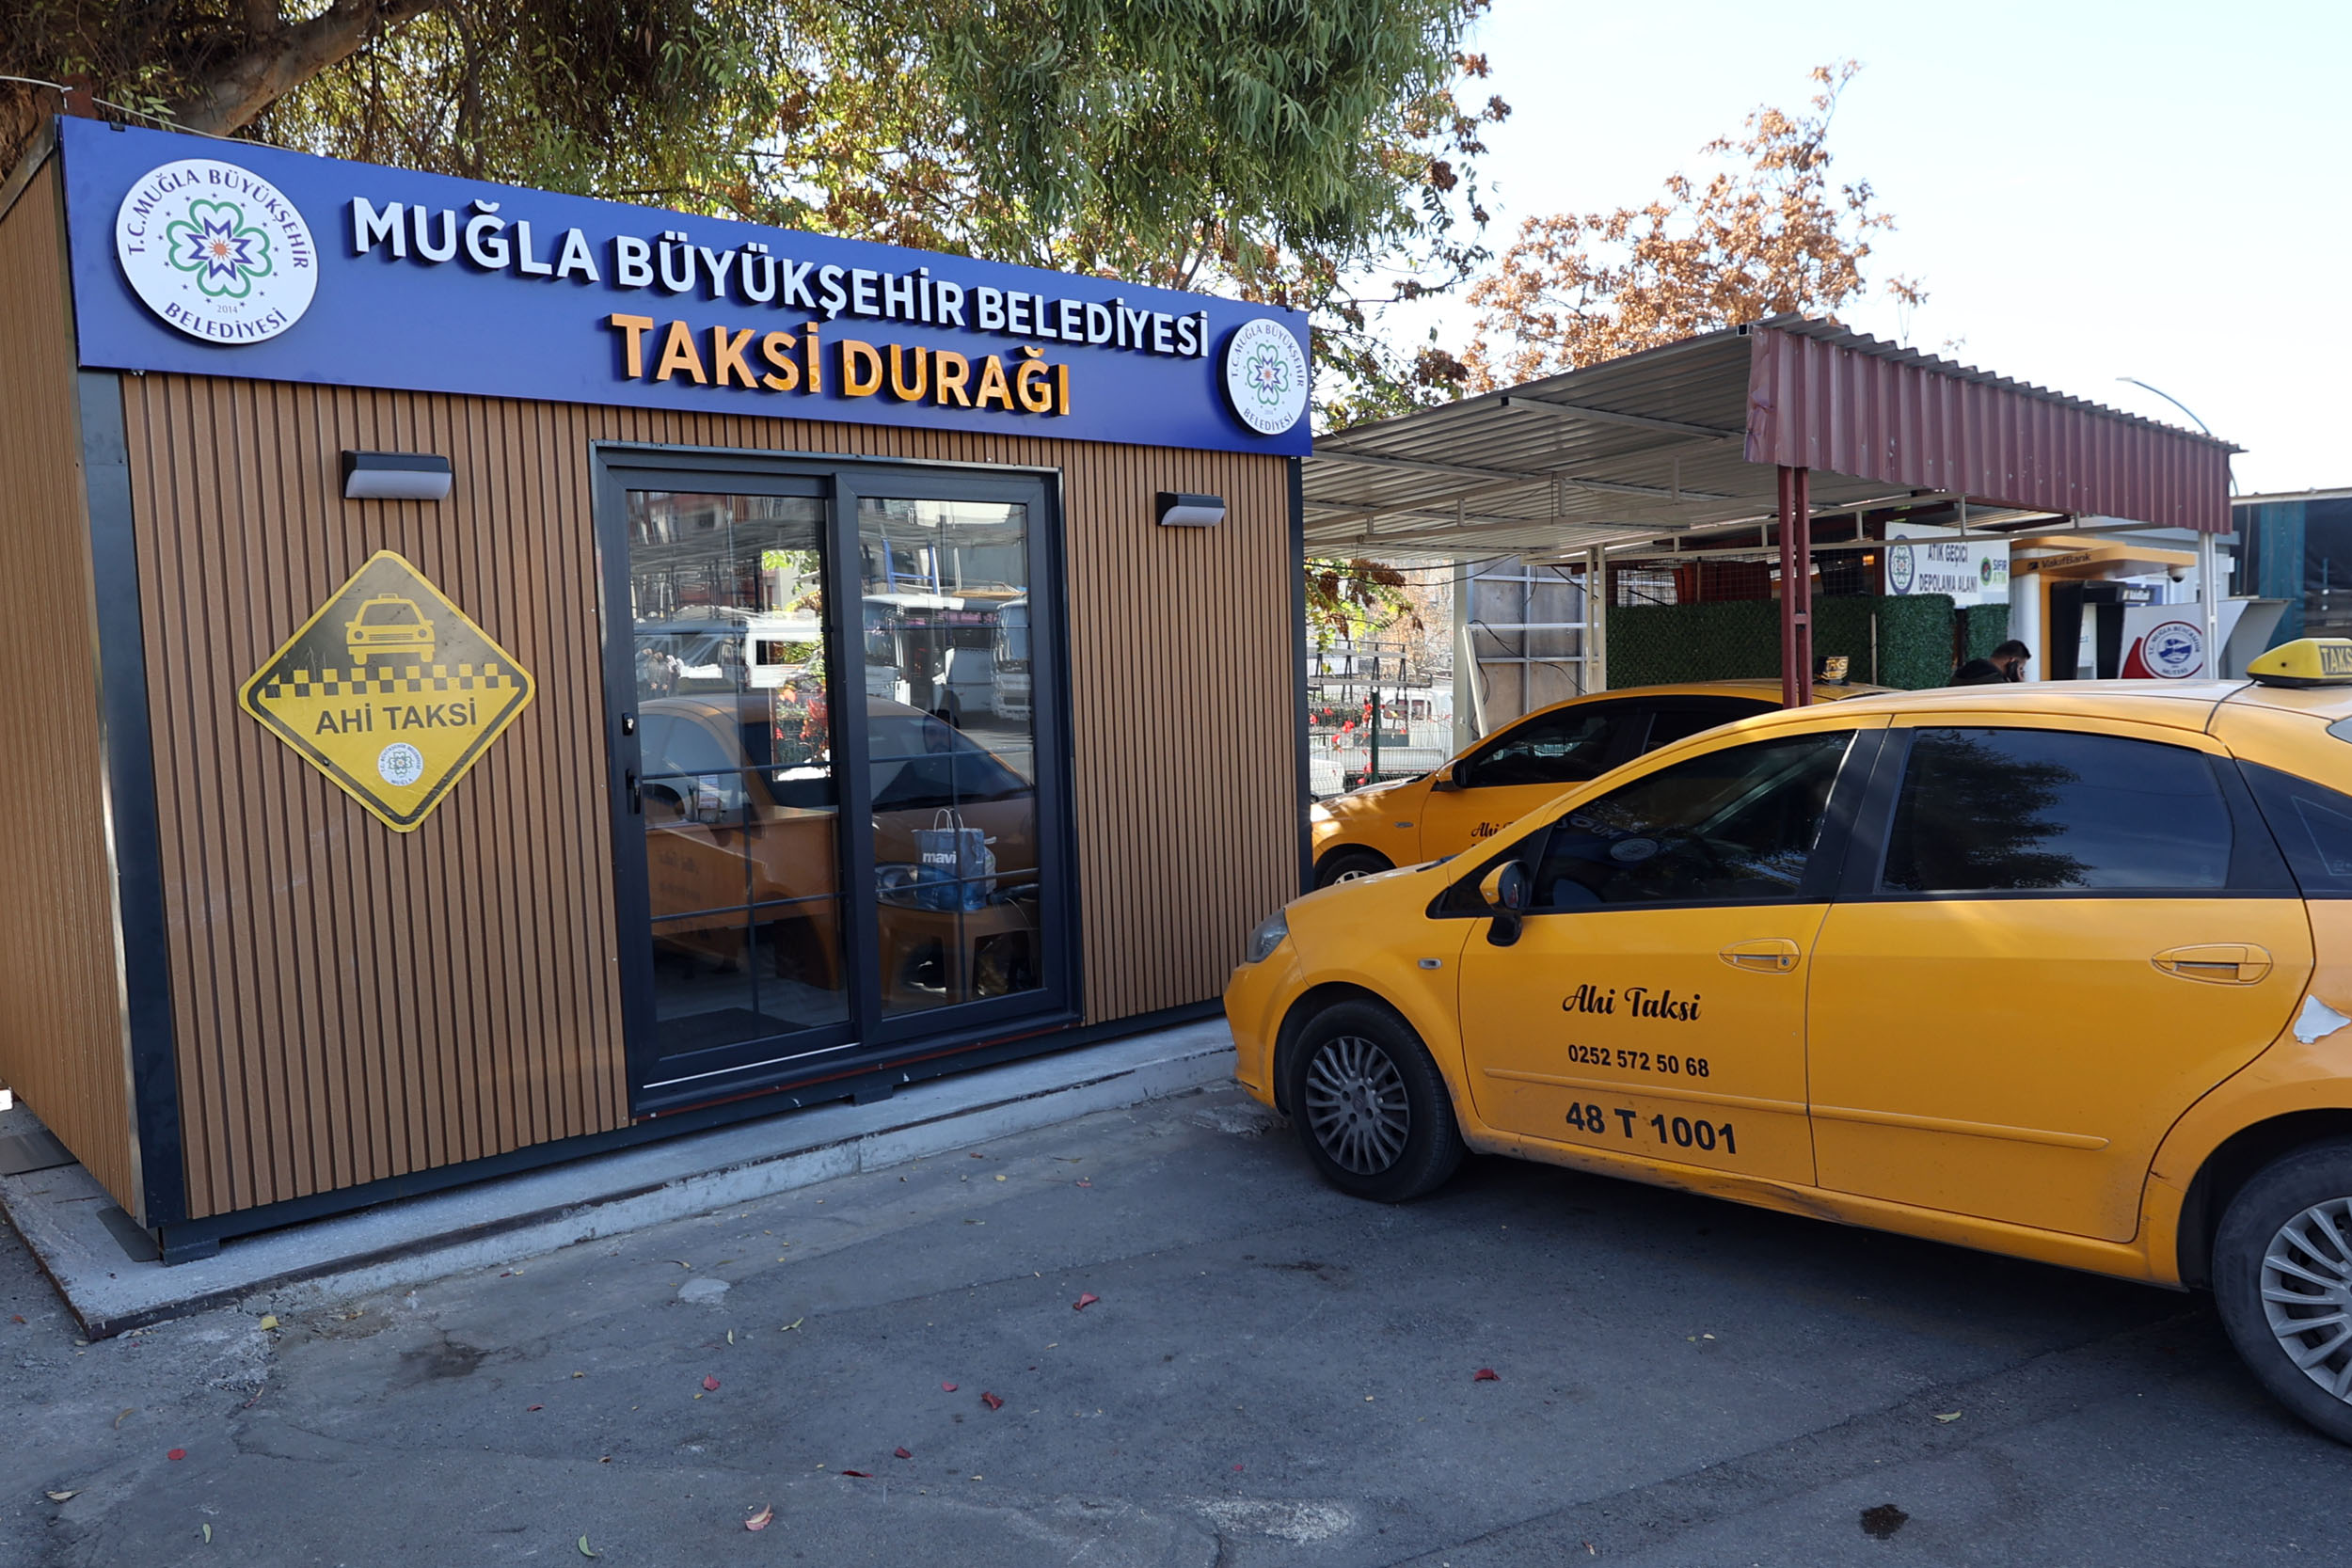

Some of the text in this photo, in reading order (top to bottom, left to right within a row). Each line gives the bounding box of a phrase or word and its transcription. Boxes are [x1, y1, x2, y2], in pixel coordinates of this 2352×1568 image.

[209, 169, 310, 269] BÜYÜKŞEHİR
[353, 197, 1209, 357] MUĞLA BÜYÜKŞEHİR BELEDİYESİ
[164, 302, 288, 339] BELEDİYESİ
[216, 304, 238, 314] 2014
[612, 313, 1071, 417] TAKSİ DURAĞI
[1243, 407, 1294, 432] BELEDİYESİ
[1919, 573, 1956, 593] DEPOLAMA
[315, 697, 478, 735] AHİ TAKSİ
[922, 850, 957, 864] mavi
[1562, 984, 1703, 1022] Ahi Taksi
[1568, 1044, 1709, 1078] 0252 572 50 68
[1565, 1101, 1737, 1155] 48 T 1001
